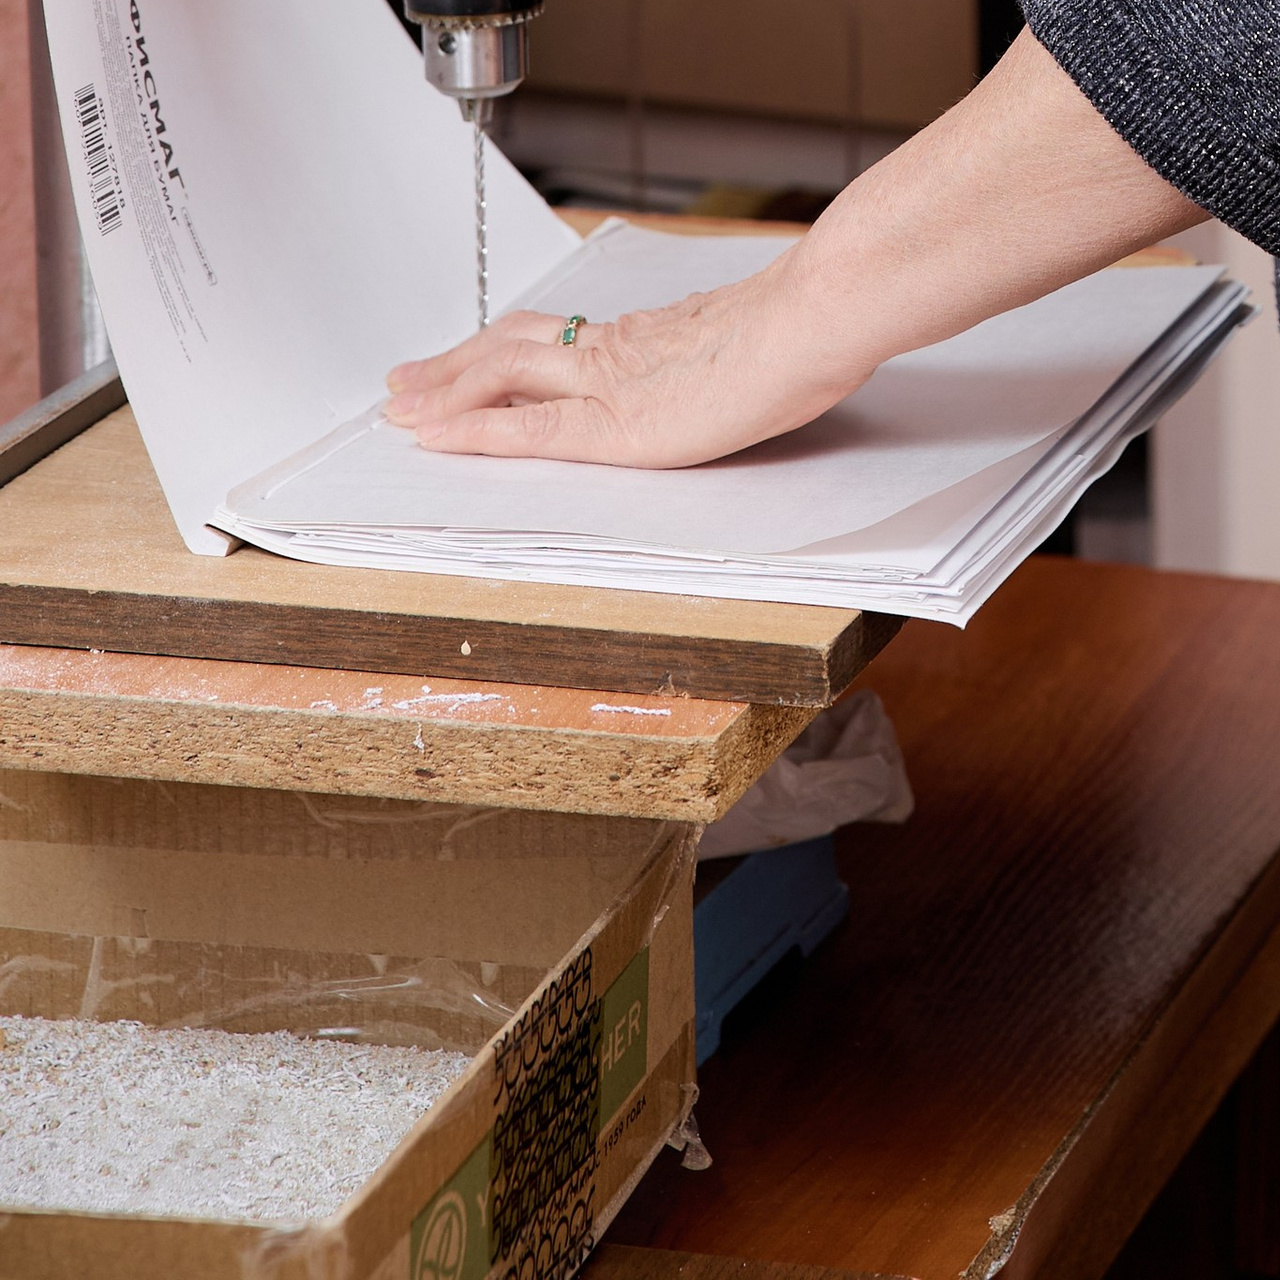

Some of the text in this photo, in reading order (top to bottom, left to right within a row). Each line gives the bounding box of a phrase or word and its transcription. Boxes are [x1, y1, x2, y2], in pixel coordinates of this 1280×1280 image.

[126, 35, 180, 228] ПАПКА ДЛЯ БУМАГ
[601, 1000, 641, 1082] HER
[604, 1121, 624, 1157] 1959
[626, 1095, 647, 1129] ГОДА
